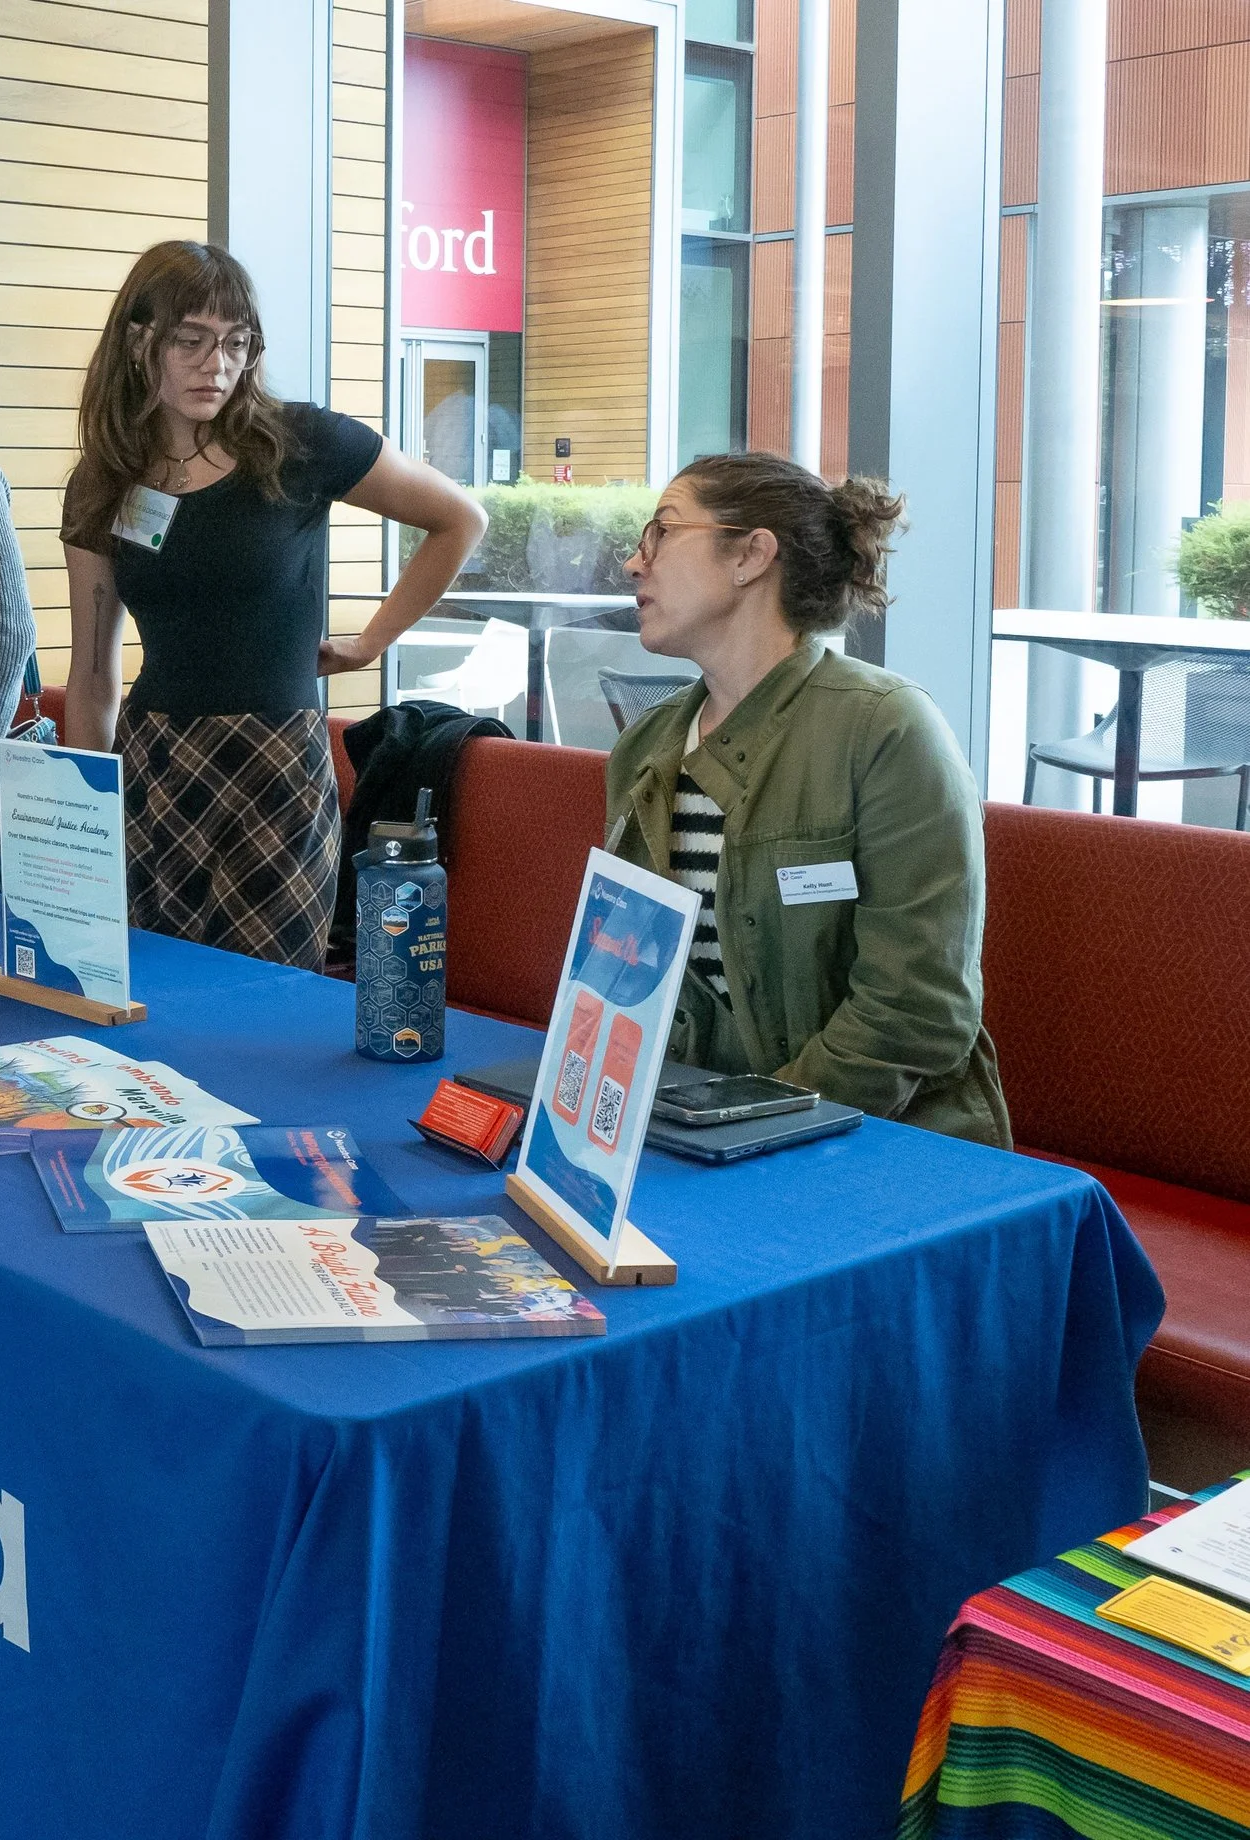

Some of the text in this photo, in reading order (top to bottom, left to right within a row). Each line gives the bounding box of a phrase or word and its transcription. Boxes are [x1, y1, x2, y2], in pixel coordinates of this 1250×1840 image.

[12, 808, 110, 840] Environmental Justice Academy
[8, 831, 18, 839] Over
[70, 843, 90, 853] students
[420, 958, 443, 972] USA
[116, 1064, 185, 1106] embrando
[116, 1088, 188, 1126] Maravilla
[334, 1140, 359, 1170] Nuestra Casa
[298, 1224, 337, 1237] A
[308, 1240, 361, 1277] Bright
[310, 1262, 357, 1317] FOR EAST PALO ALTO
[338, 1280, 382, 1318] Future
